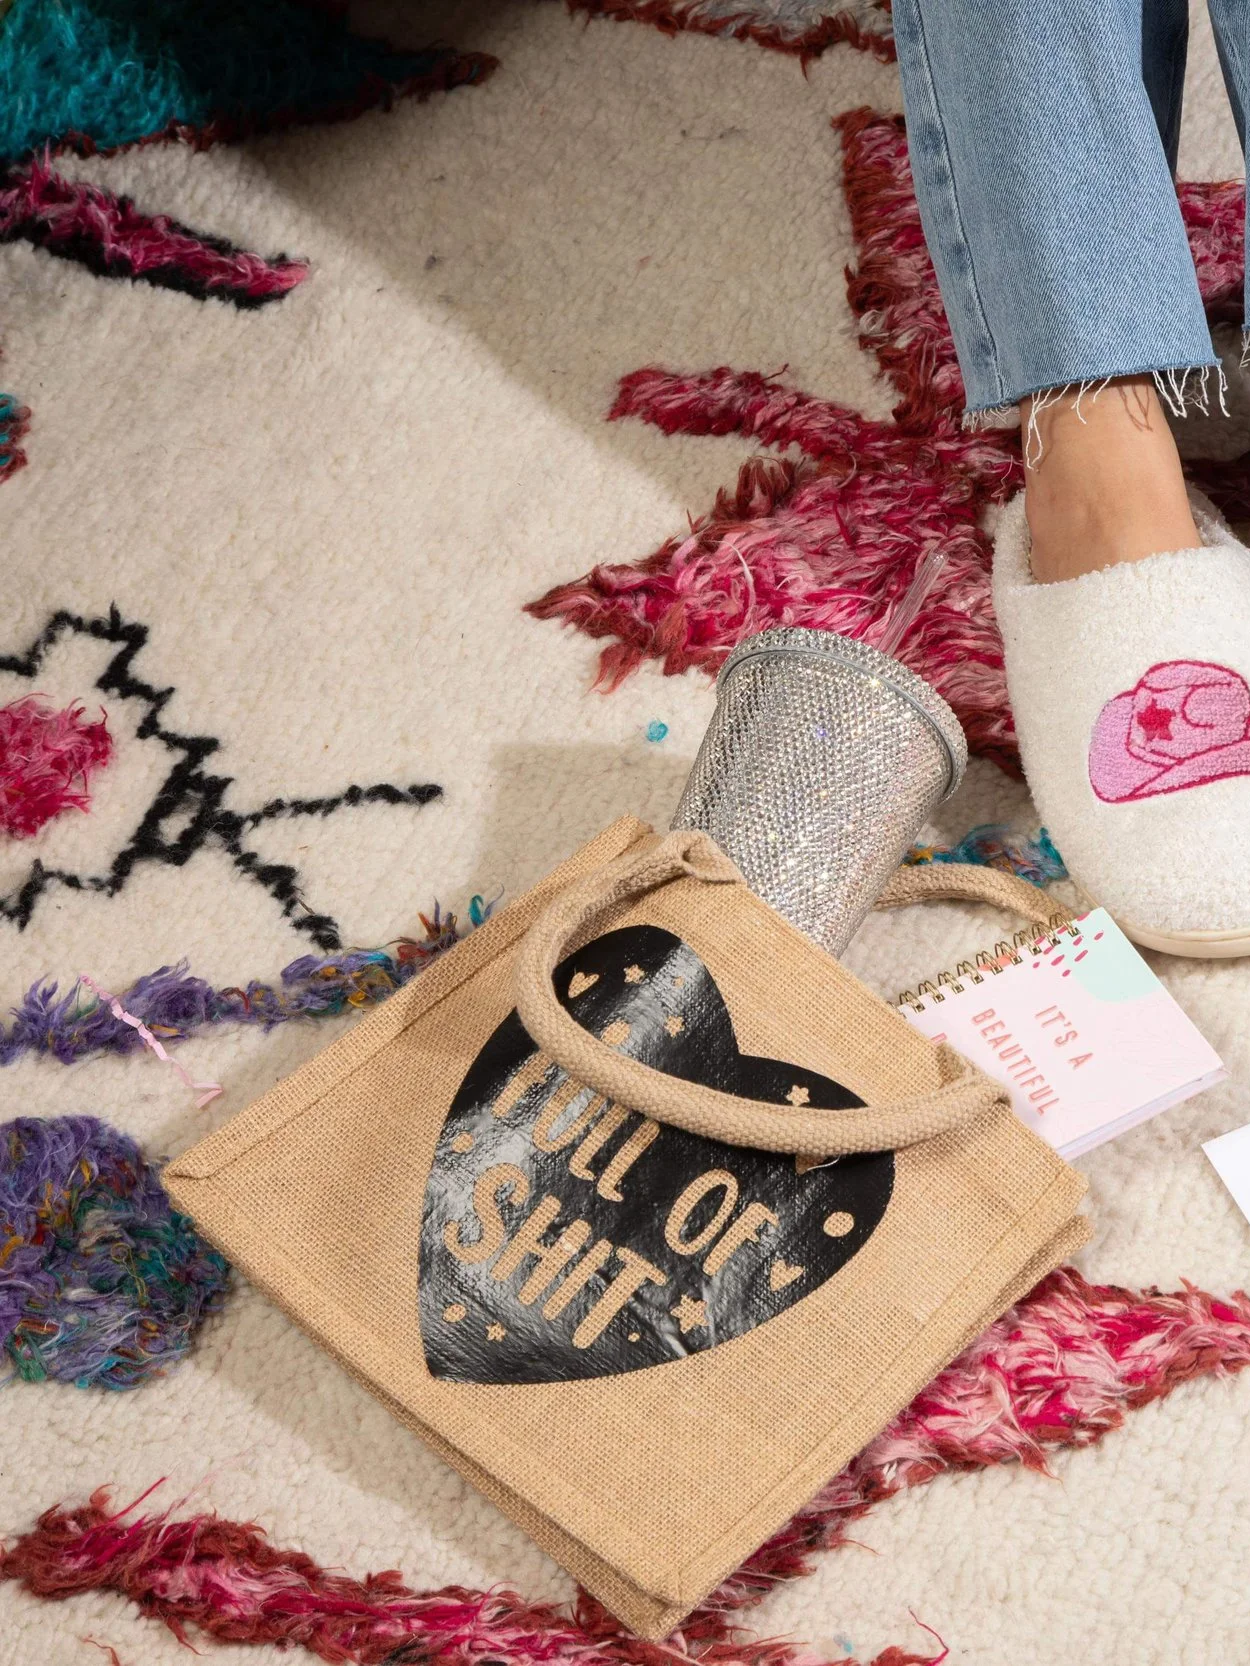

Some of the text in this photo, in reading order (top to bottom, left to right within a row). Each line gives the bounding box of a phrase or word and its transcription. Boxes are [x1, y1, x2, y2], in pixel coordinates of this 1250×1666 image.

[971, 1008, 1060, 1116] BEAUTIFUL
[1035, 1004, 1094, 1071] IT'S A
[491, 1050, 782, 1277] FULL OF
[443, 1162, 667, 1350] SHIT
